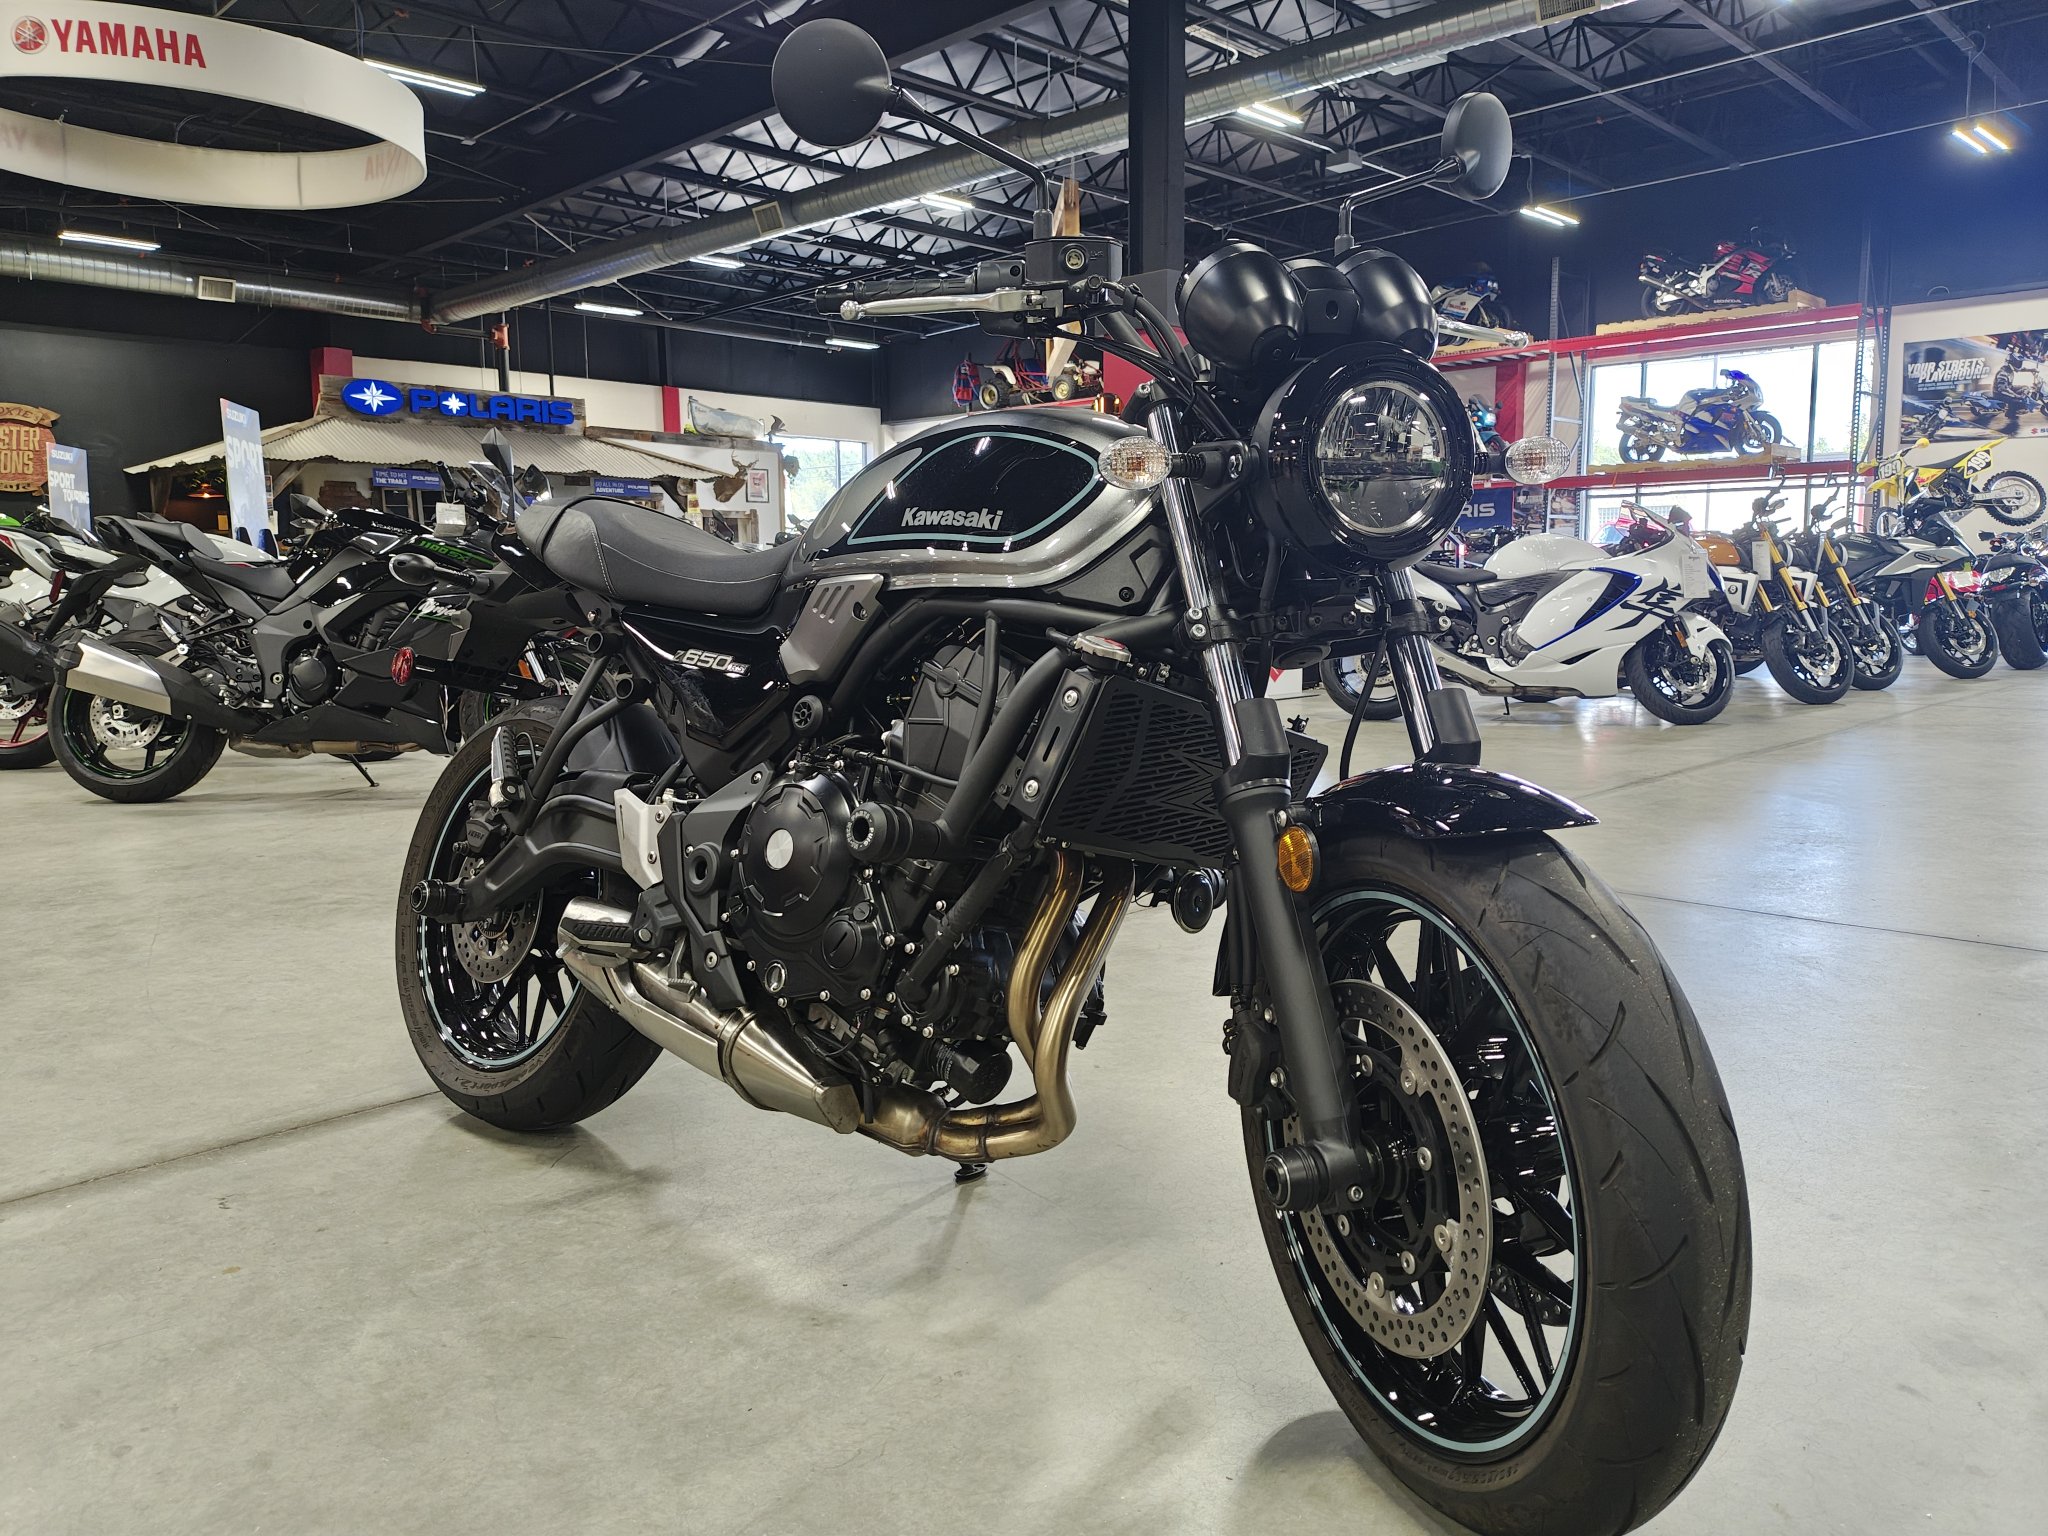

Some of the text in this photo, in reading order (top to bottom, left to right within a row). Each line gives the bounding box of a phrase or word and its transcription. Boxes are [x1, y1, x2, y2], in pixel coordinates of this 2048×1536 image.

[51, 19, 206, 68] YAMAHA
[1907, 357, 1986, 377] YOUR STREETS
[409, 388, 575, 425] POLARIS
[0, 425, 40, 450] STER
[0, 450, 34, 474] ONS
[51, 449, 73, 461] SUZUKI
[226, 435, 264, 474] SPORT
[1967, 451, 1991, 471] 199
[49, 470, 76, 490] SPORT
[901, 506, 1003, 530] Kawasaki
[1460, 502, 1496, 518] RIS
